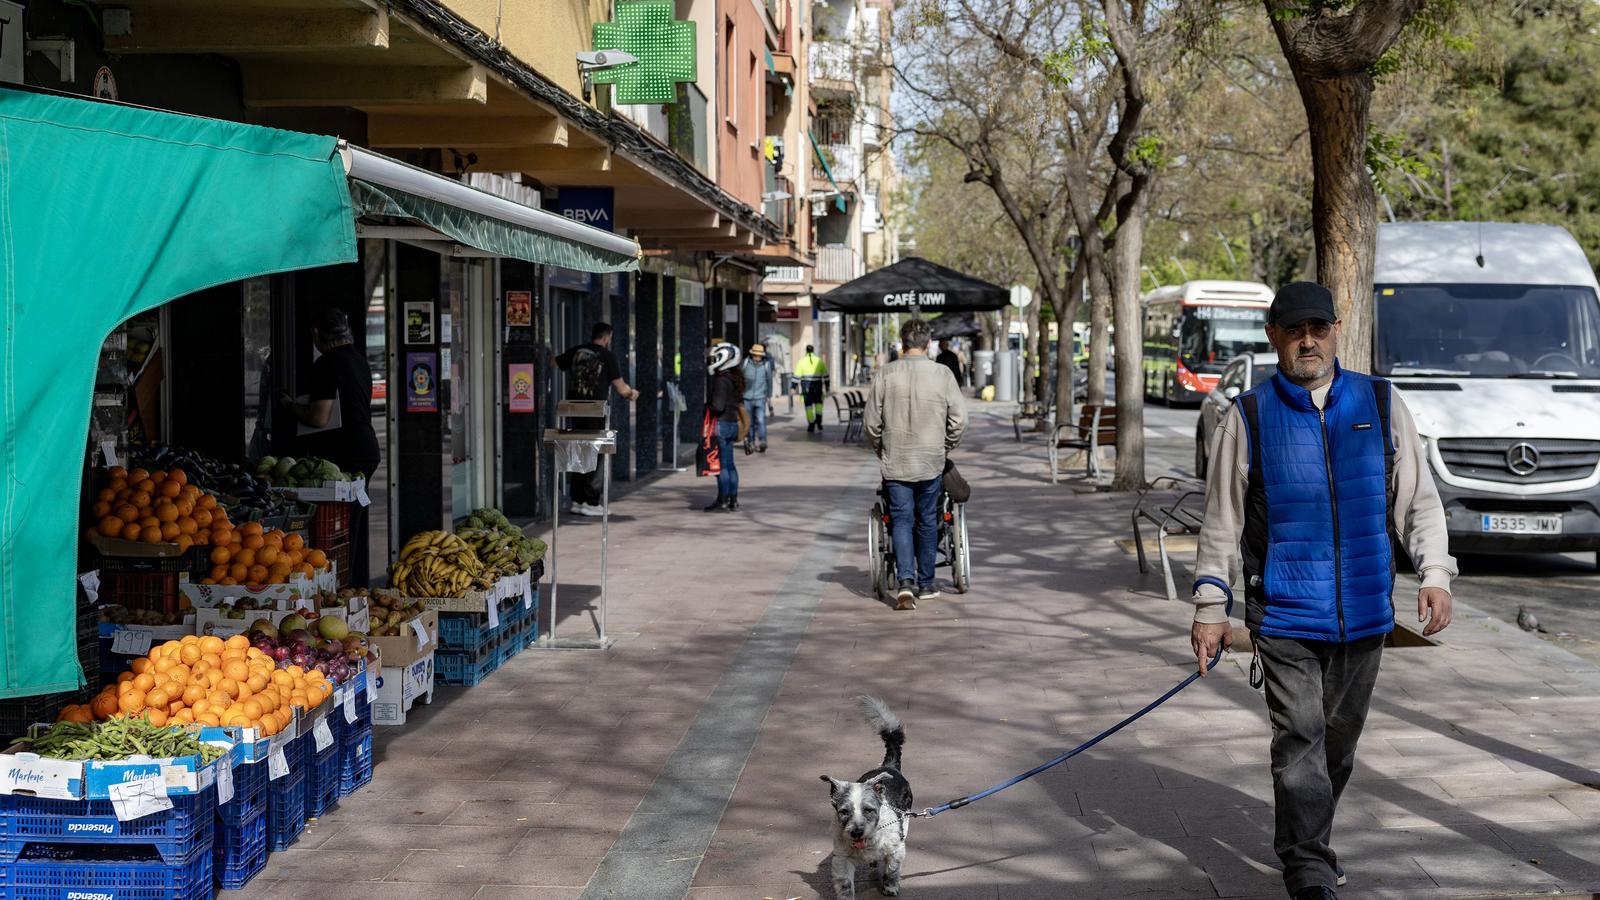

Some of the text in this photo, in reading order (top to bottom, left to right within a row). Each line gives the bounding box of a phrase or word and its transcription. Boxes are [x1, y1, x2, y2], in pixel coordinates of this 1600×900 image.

[563, 208, 609, 222] BBVA
[883, 290, 946, 306] CAFÉ KIWI
[1491, 517, 1526, 530] 3535
[1533, 519, 1558, 531] JMV
[8, 768, 44, 784] Marlene
[68, 823, 114, 833] Plasencia
